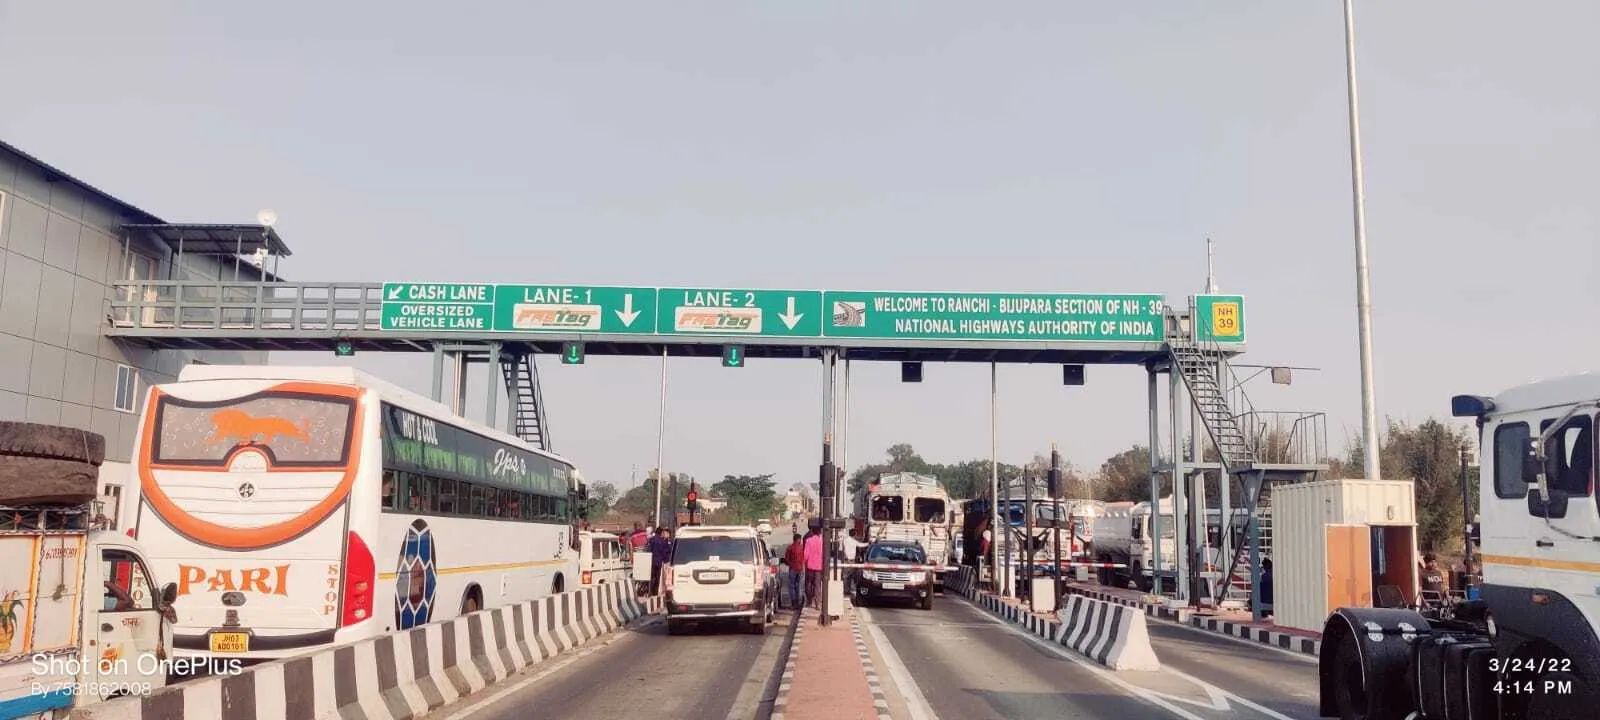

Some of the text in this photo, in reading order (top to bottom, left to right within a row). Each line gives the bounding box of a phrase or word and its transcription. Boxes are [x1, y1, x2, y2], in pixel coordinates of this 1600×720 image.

[409, 285, 486, 300] CASH LANE
[585, 289, 592, 304] 1
[744, 291, 755, 307] 2
[401, 305, 474, 316] OVERSIZED
[874, 297, 928, 313] WELCOME
[931, 297, 946, 313] TO
[948, 298, 990, 313] RANCHI
[999, 298, 1052, 314] BIJUPARA
[1055, 299, 1102, 314] SECTION
[1106, 300, 1121, 314] OF
[1123, 300, 1140, 315] NH
[1149, 300, 1163, 315] 39
[1218, 308, 1233, 316] NH
[390, 316, 484, 328] VEHICLE LANE
[895, 318, 1154, 336] NATIONAL HIGHWAYS AUTHORITY OF INDIA
[1218, 319, 1234, 329] 39
[402, 411, 416, 440] HOT
[422, 417, 439, 446] COOL
[177, 563, 291, 597] PARI
[324, 564, 338, 615] STOP
